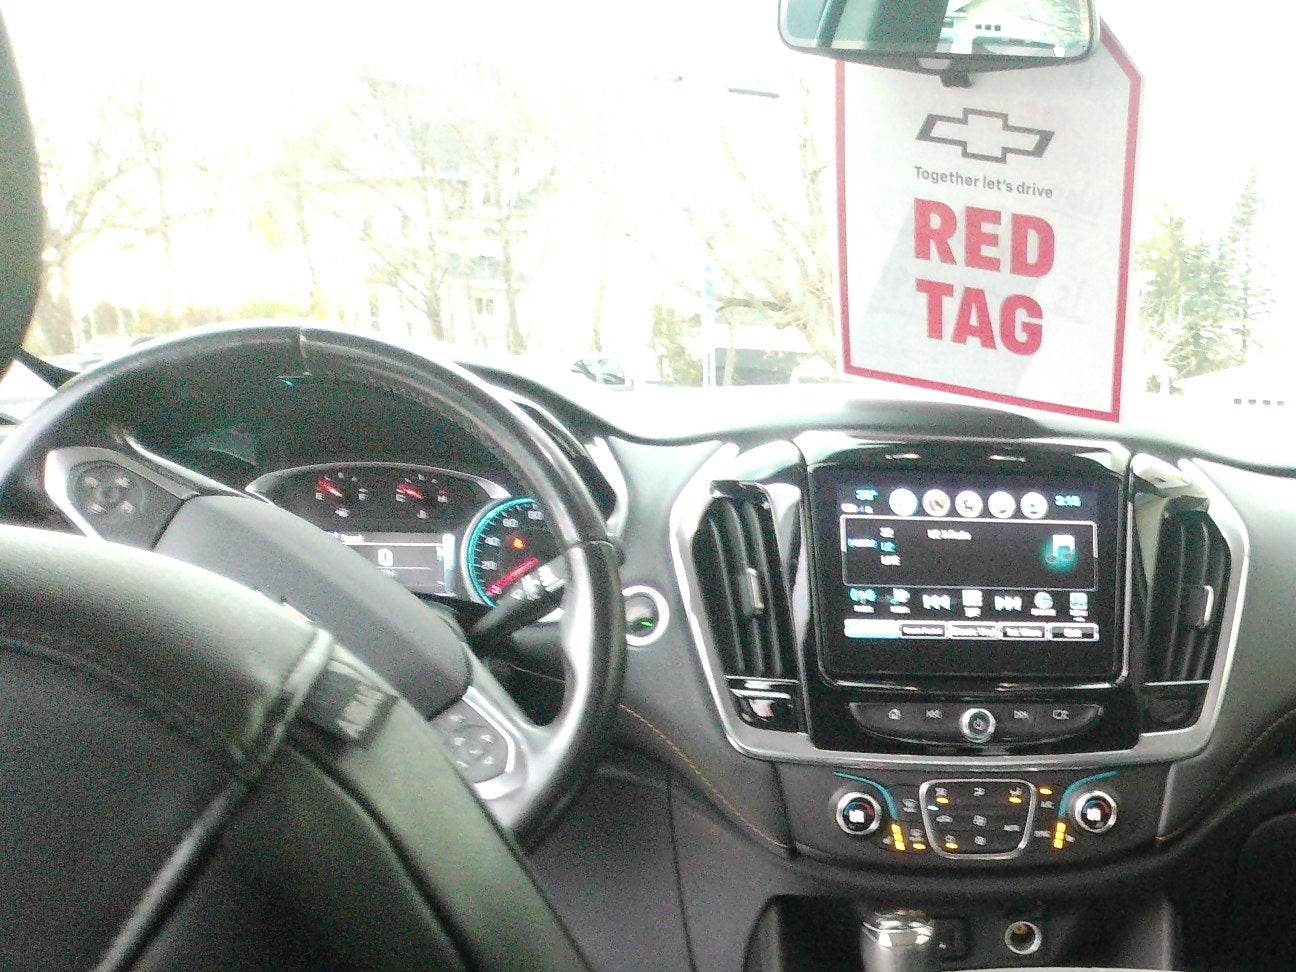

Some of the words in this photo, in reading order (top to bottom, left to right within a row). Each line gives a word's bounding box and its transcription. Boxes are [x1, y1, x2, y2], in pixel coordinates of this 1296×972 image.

[914, 166, 979, 188] Together
[982, 176, 1013, 192] let's
[1017, 181, 1053, 199] drive
[914, 197, 1056, 278] RED
[915, 278, 1044, 356] TAG
